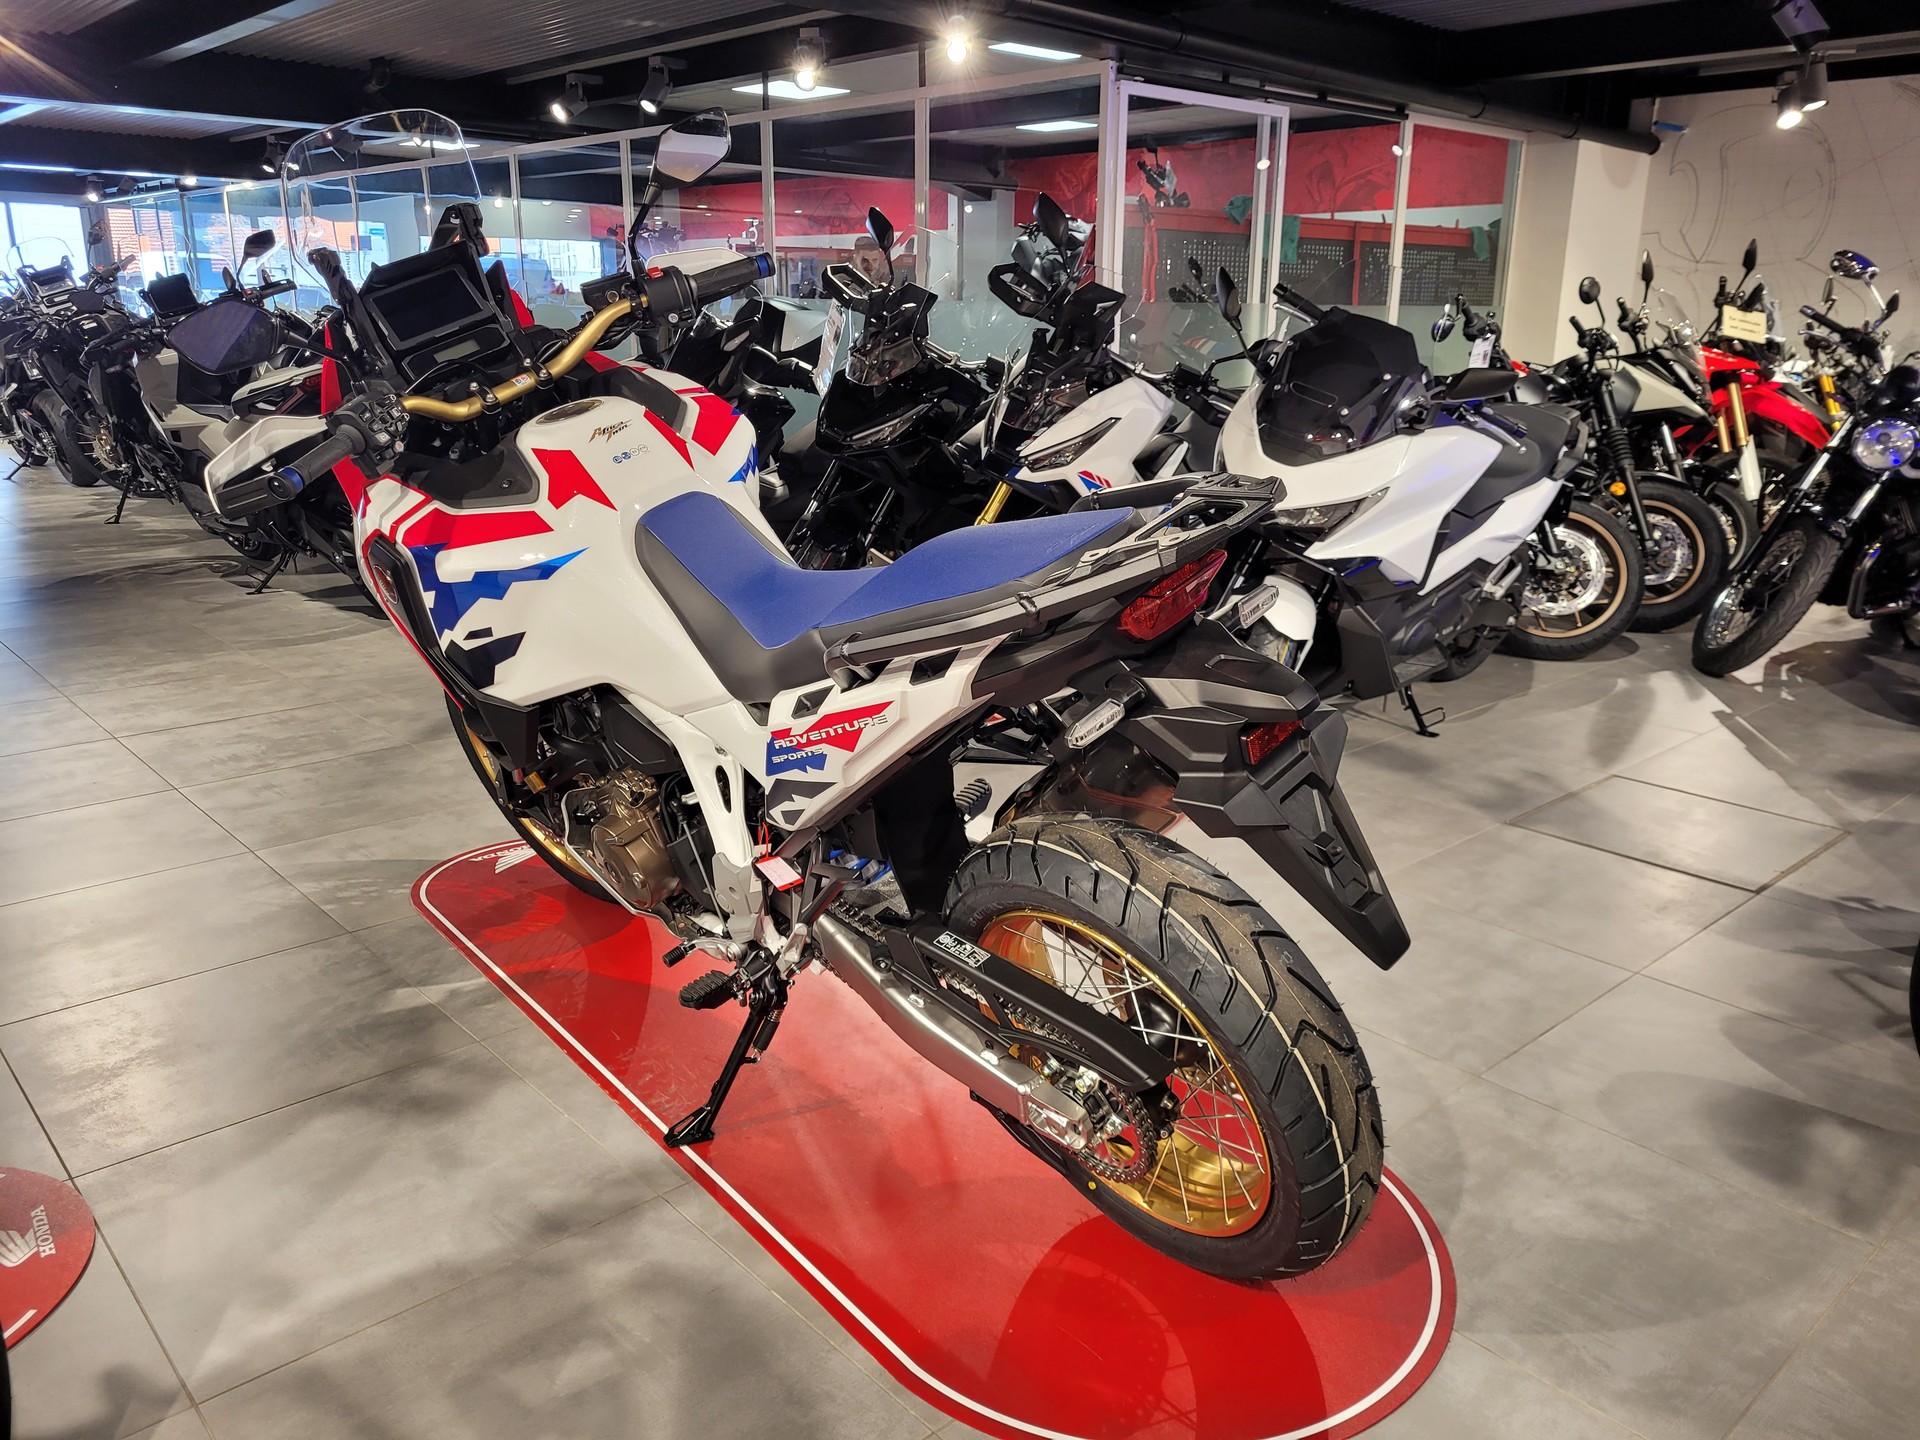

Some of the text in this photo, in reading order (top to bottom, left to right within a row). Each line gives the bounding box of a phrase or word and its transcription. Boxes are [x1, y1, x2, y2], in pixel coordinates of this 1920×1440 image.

[773, 714, 889, 750] ADVENTURE
[771, 747, 824, 764] SPORTS
[31, 1204, 56, 1258] HONDA
